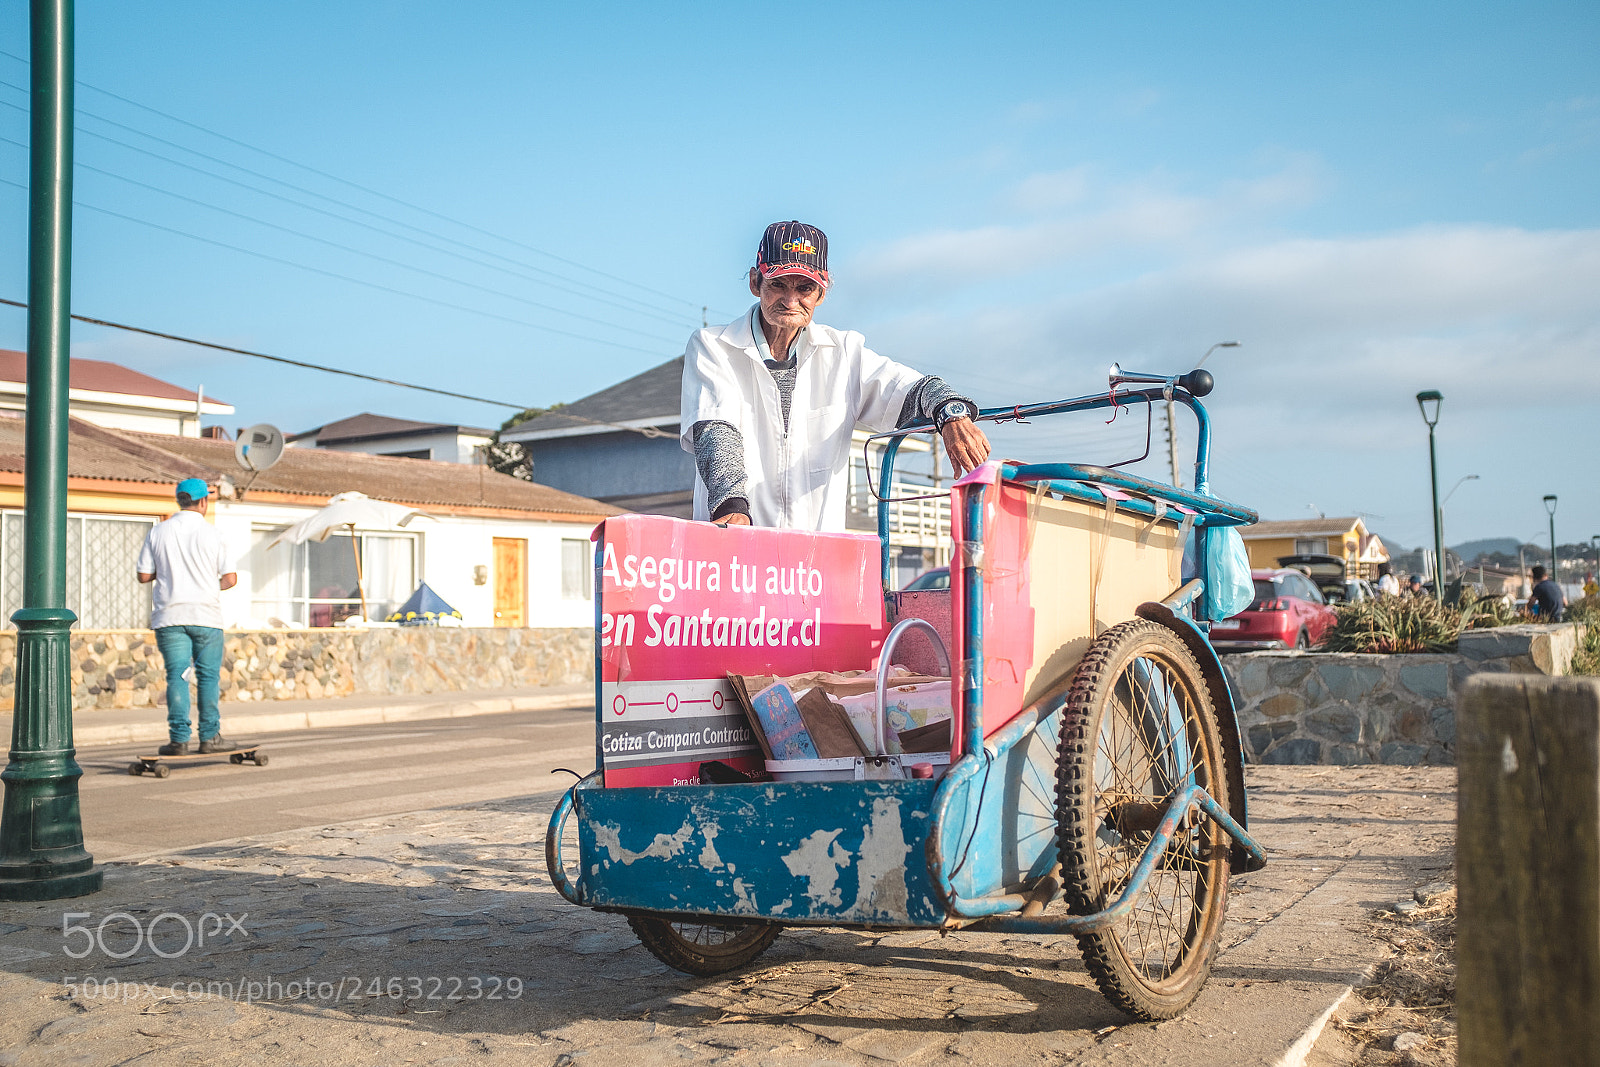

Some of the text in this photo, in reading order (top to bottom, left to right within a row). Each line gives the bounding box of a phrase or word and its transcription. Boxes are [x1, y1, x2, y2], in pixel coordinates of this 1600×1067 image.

[782, 242, 816, 255] CHILE
[603, 542, 822, 602] Asegura tu auto
[602, 604, 820, 647] en Santander.cl
[602, 727, 750, 753] Cotiza Compara Contrata
[672, 777, 688, 787] Para
